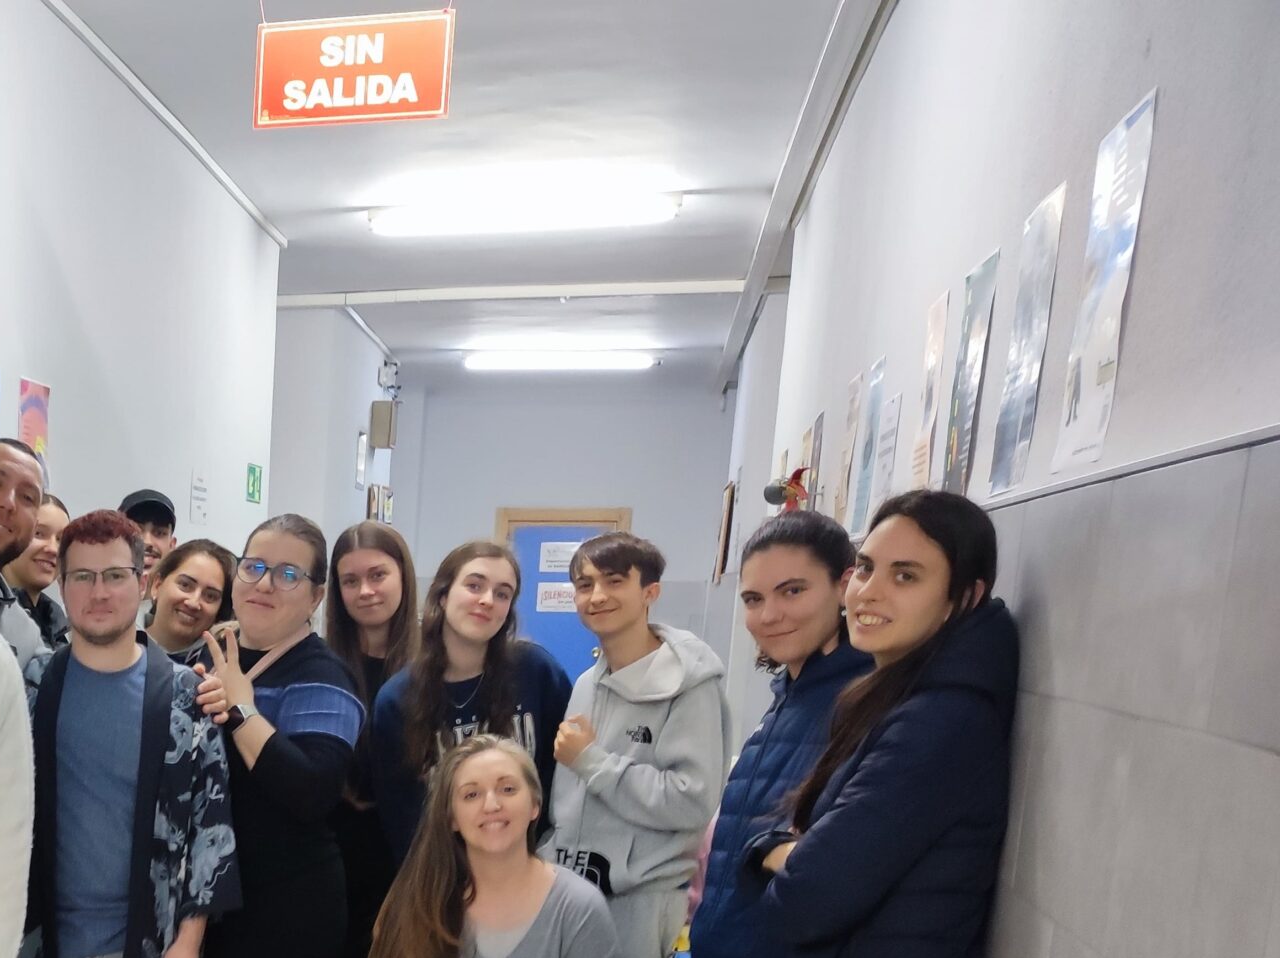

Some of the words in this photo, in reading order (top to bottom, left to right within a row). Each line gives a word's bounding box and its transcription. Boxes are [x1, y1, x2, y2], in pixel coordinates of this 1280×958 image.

[319, 32, 385, 68] SIN
[282, 72, 419, 111] SALIDA
[555, 848, 588, 867] THE
